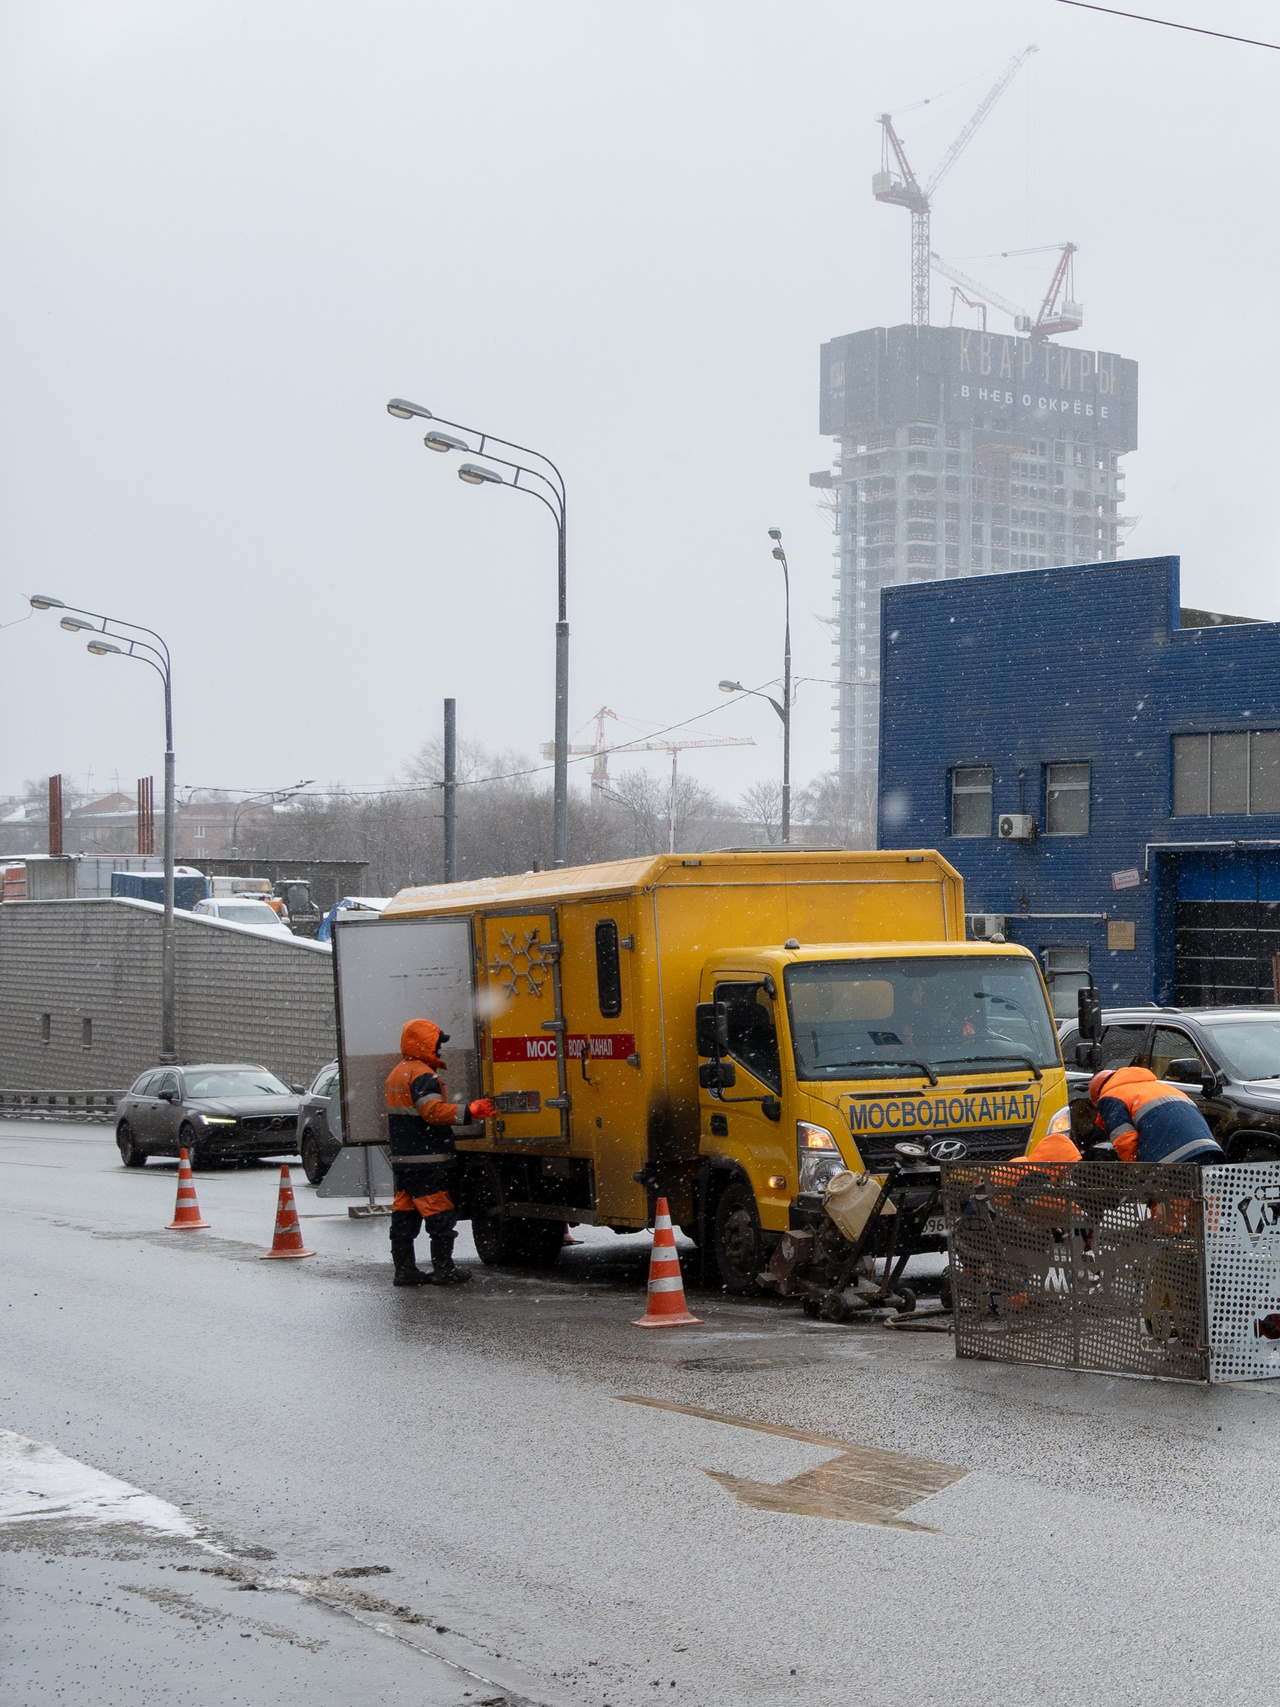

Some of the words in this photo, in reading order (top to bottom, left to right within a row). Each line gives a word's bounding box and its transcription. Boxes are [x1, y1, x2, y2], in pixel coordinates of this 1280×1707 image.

[960, 330, 1115, 394] КВАРТИРЫ
[961, 385, 970, 398] В
[979, 388, 1109, 419] НЕБОСКРЁБЕ
[527, 1040, 557, 1058] МОС
[849, 1093, 1035, 1131] МОСВОДОКАНАЛ
